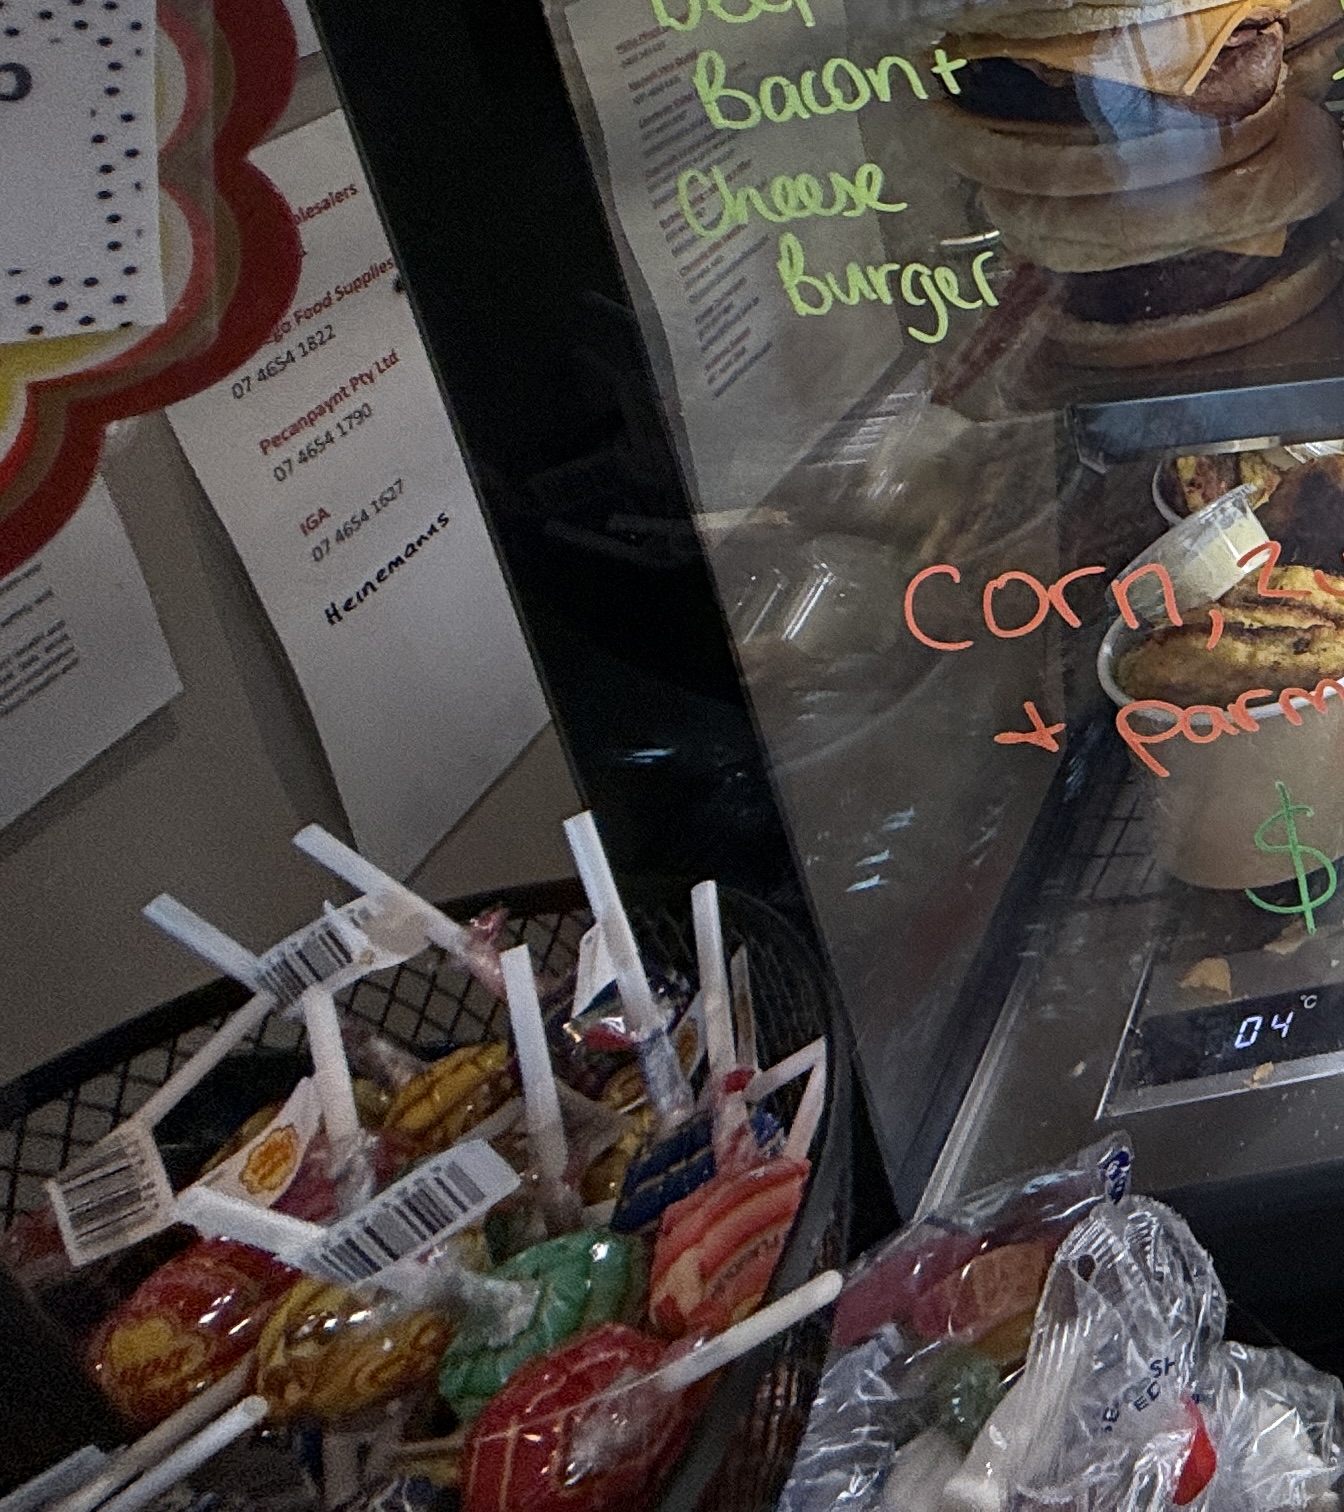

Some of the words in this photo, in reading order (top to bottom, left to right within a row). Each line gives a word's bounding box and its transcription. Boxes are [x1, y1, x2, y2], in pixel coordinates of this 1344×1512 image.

[294, 183, 358, 226] olesalers
[675, 161, 908, 240] Cheese
[293, 288, 334, 325] Food
[333, 256, 395, 302] Supplies
[776, 232, 1001, 345] Burger
[231, 374, 253, 400] 07
[257, 350, 297, 383] 4654
[298, 324, 337, 358] 1822
[374, 348, 401, 376] Ltd
[273, 458, 294, 483] 07
[297, 429, 336, 465] 4654
[336, 402, 374, 437] 1790
[300, 506, 332, 537] IGA
[312, 538, 332, 564] 07
[1234, 1010, 1296, 1049] 04
